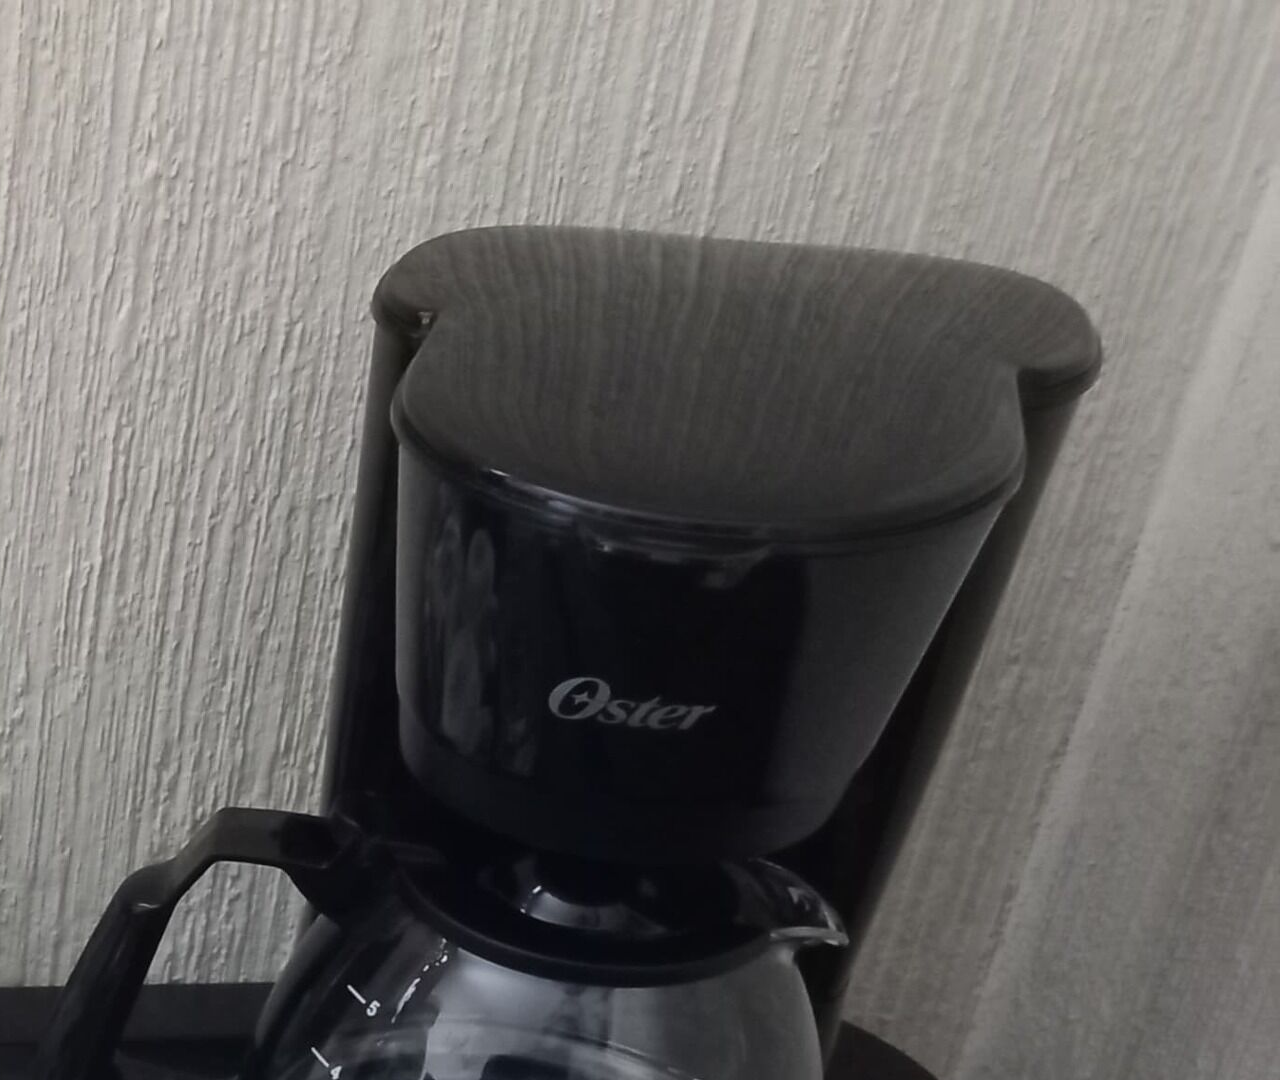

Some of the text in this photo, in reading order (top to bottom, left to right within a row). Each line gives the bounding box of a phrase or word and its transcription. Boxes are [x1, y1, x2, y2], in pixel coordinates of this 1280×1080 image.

[548, 676, 718, 731] Oster
[366, 1000, 381, 1017] 5
[330, 1065, 343, 1080] 4
